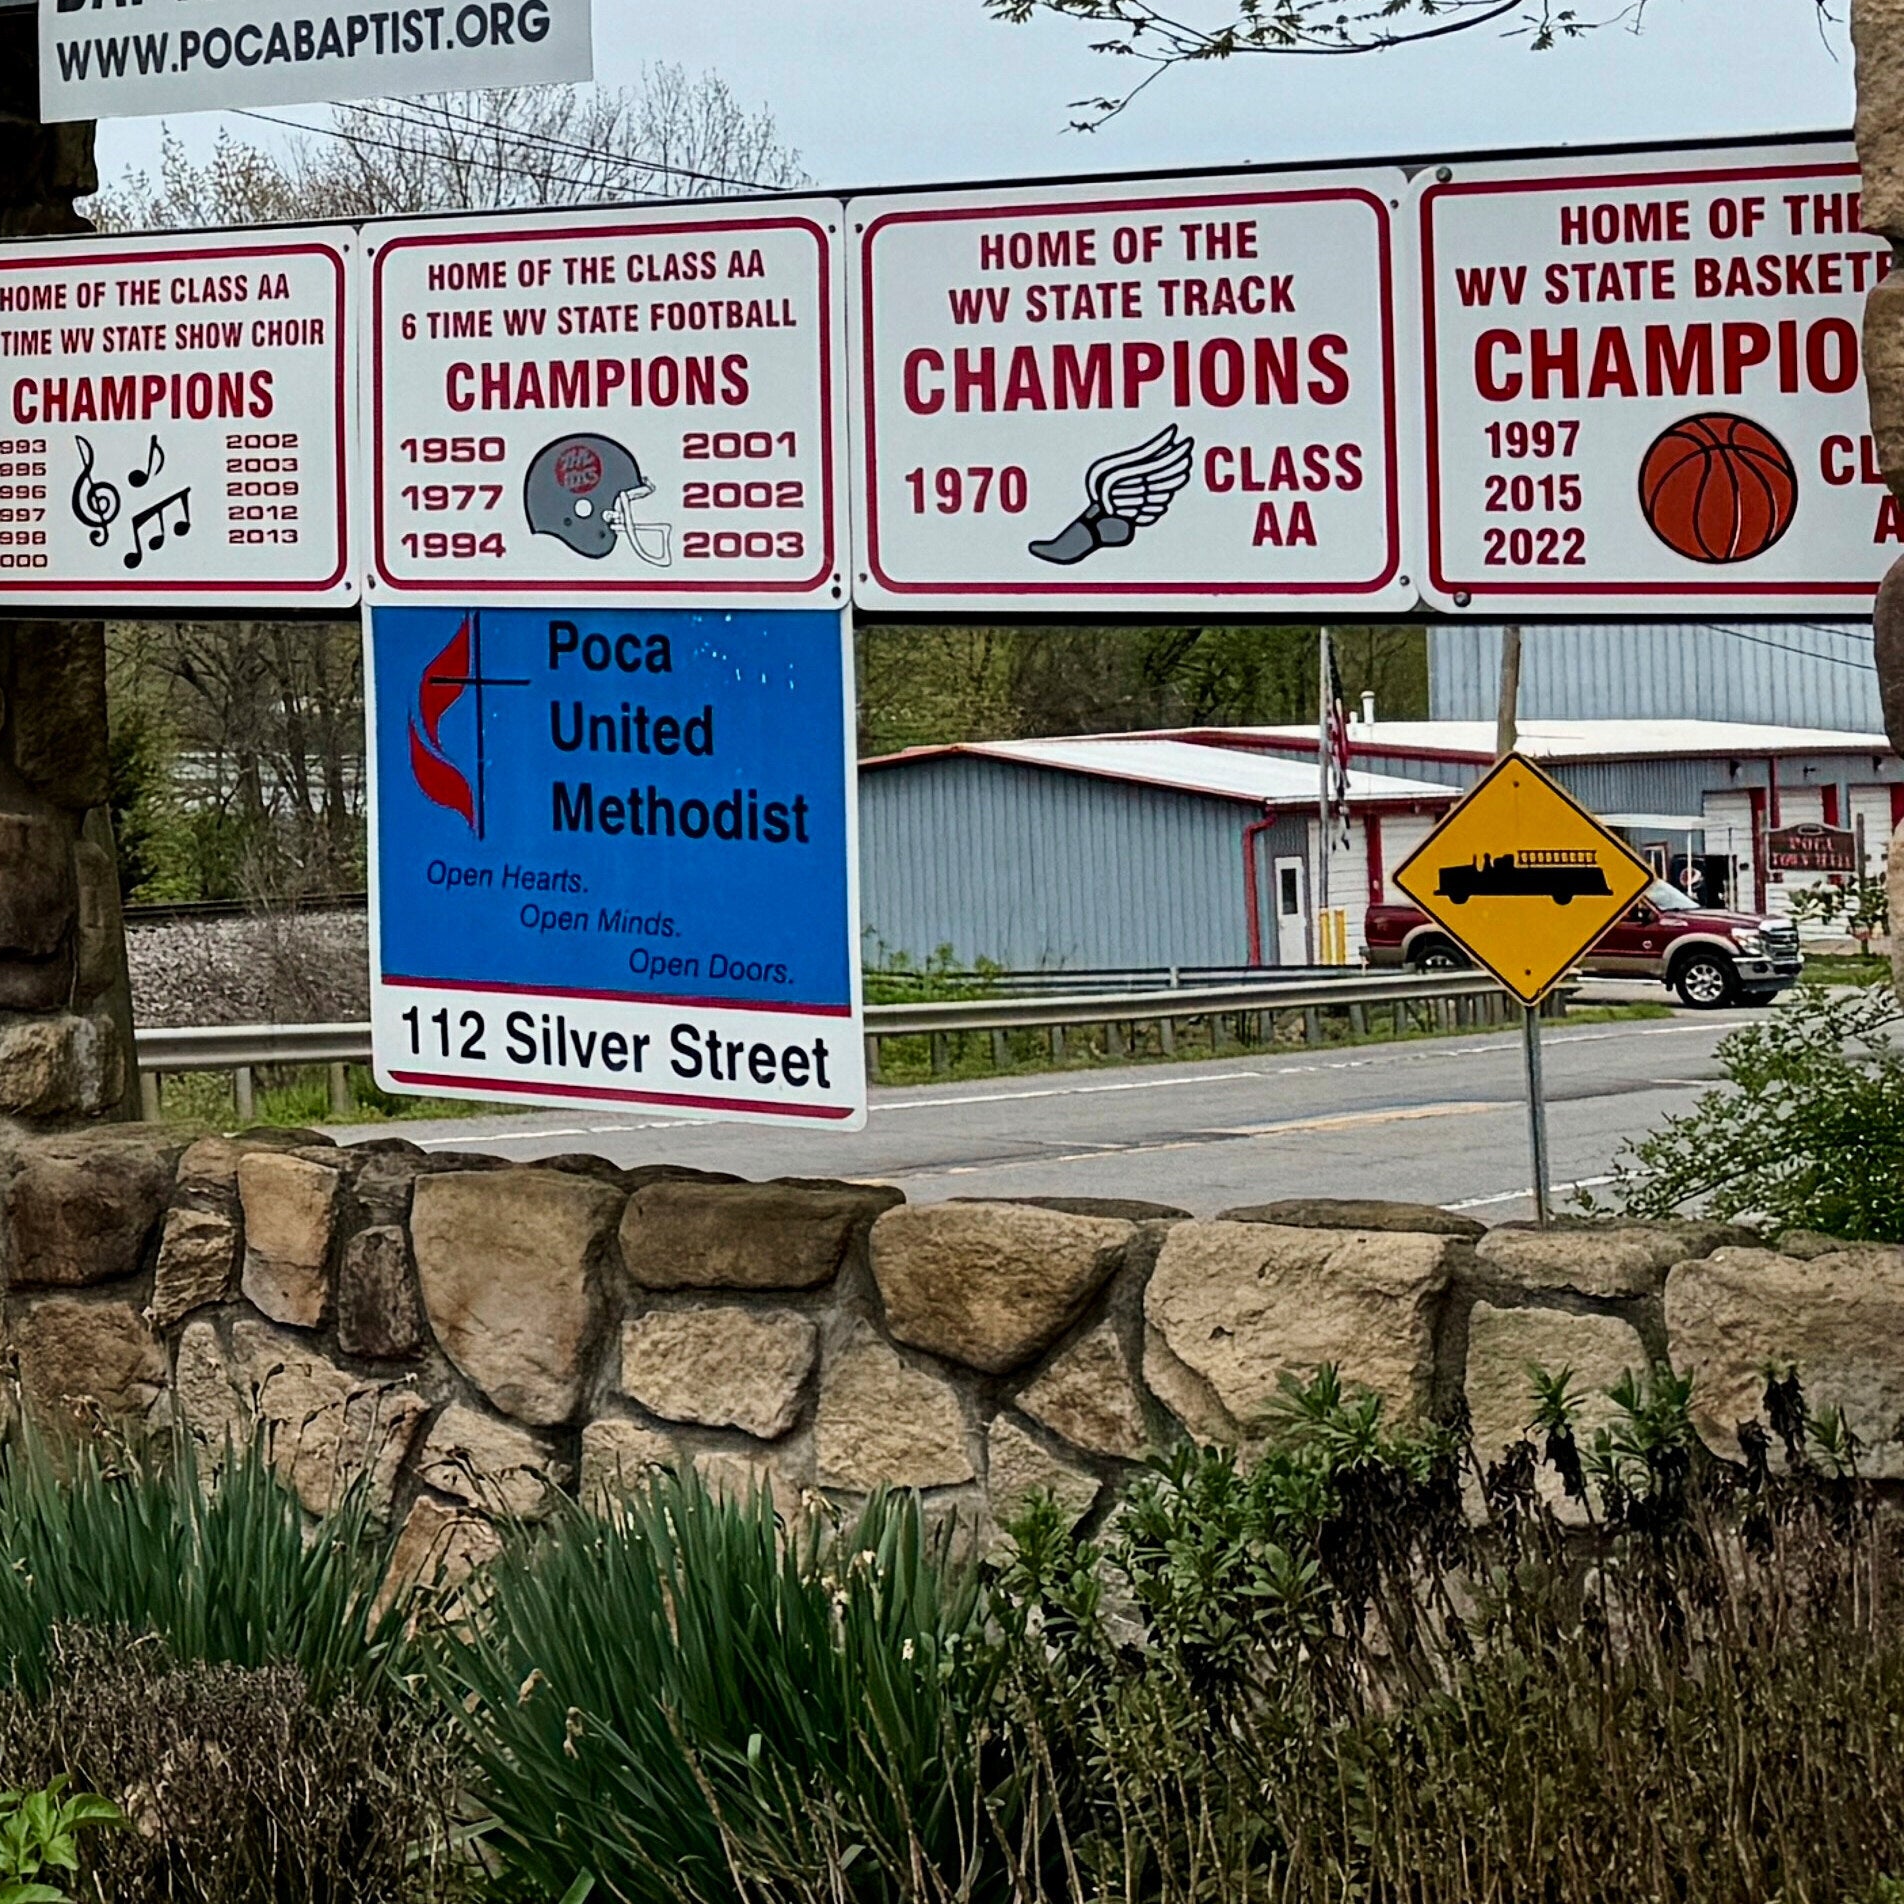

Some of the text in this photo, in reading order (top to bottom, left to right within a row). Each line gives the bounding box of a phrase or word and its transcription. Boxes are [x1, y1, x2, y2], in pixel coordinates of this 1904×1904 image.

[57, 0, 550, 81] WWW.POCABAPTIST.ORG
[1561, 200, 1690, 245] HOME
[1709, 196, 1765, 239] OF
[981, 220, 1257, 270] HOME OF THE
[429, 249, 764, 291] HOME OF THE CLASS AA
[1455, 251, 1893, 306] WV STATE BASKET
[0, 274, 289, 312] HOME OF THE CLASS AA
[949, 275, 1295, 324] WV STATE TRACK
[1, 329, 51, 356] TIME
[61, 328, 94, 354] WV
[103, 325, 166, 353] STATE
[176, 322, 243, 350] SHOW
[252, 319, 323, 347] CHOIR
[402, 299, 796, 340] 6 TIME WV STATE FOOTBALL
[904, 334, 1349, 415] CHAMPIONS
[1474, 317, 1859, 402] CHAMPIO
[13, 370, 273, 424] CHAMPIONS
[447, 354, 749, 412] CHAMPIONS
[226, 434, 298, 449] 2002
[400, 437, 505, 463] 1950
[683, 432, 795, 459] 2001
[1485, 420, 1580, 458] 1997
[226, 458, 297, 473] 2003
[1205, 443, 1362, 492] CLASS
[227, 481, 298, 496] 2009
[402, 485, 503, 510] 1977
[683, 481, 803, 508] 2002
[905, 466, 1027, 514] 1970
[1485, 474, 1581, 511] 2015
[228, 506, 298, 520] 2012
[1253, 501, 1317, 546] AA
[229, 529, 298, 544] 2013
[401, 533, 506, 558] 1994
[683, 532, 803, 558] 2003
[1484, 527, 1586, 565] 2022
[549, 620, 672, 674] Poca
[551, 700, 713, 756] United
[553, 781, 809, 844] Methodist
[427, 860, 588, 893] Open Hearts.
[520, 904, 680, 937] Open Minds.
[629, 948, 794, 984] Open Doors.
[403, 1006, 830, 1088] 112 Silver Street
